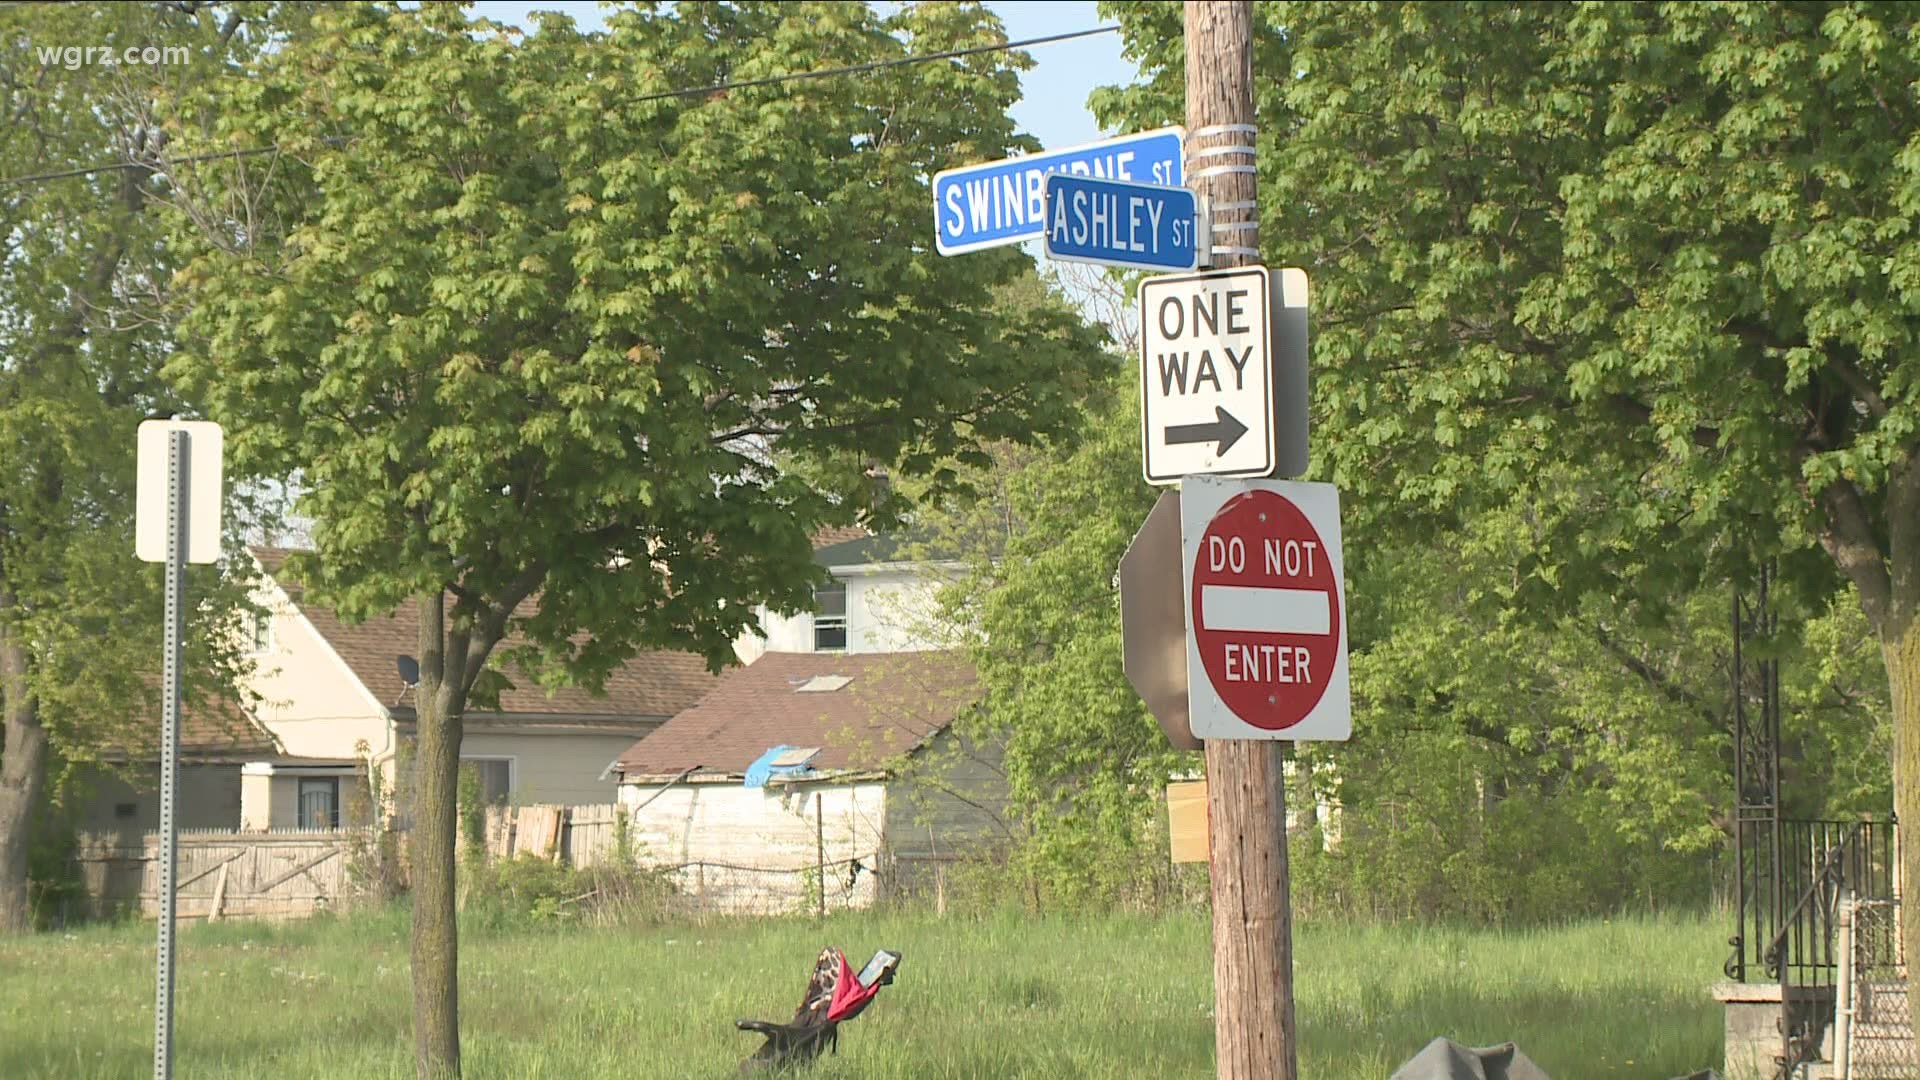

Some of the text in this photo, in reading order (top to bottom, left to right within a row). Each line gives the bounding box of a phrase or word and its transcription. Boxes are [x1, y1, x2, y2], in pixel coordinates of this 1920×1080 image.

[945, 151, 1173, 238] SWINBE ST
[1052, 187, 1190, 254] ASHLEY ST
[1158, 289, 1250, 341] ONE
[1157, 345, 1254, 397] WAY
[1209, 535, 1317, 577] DO NOT
[1224, 643, 1312, 684] ENTER
